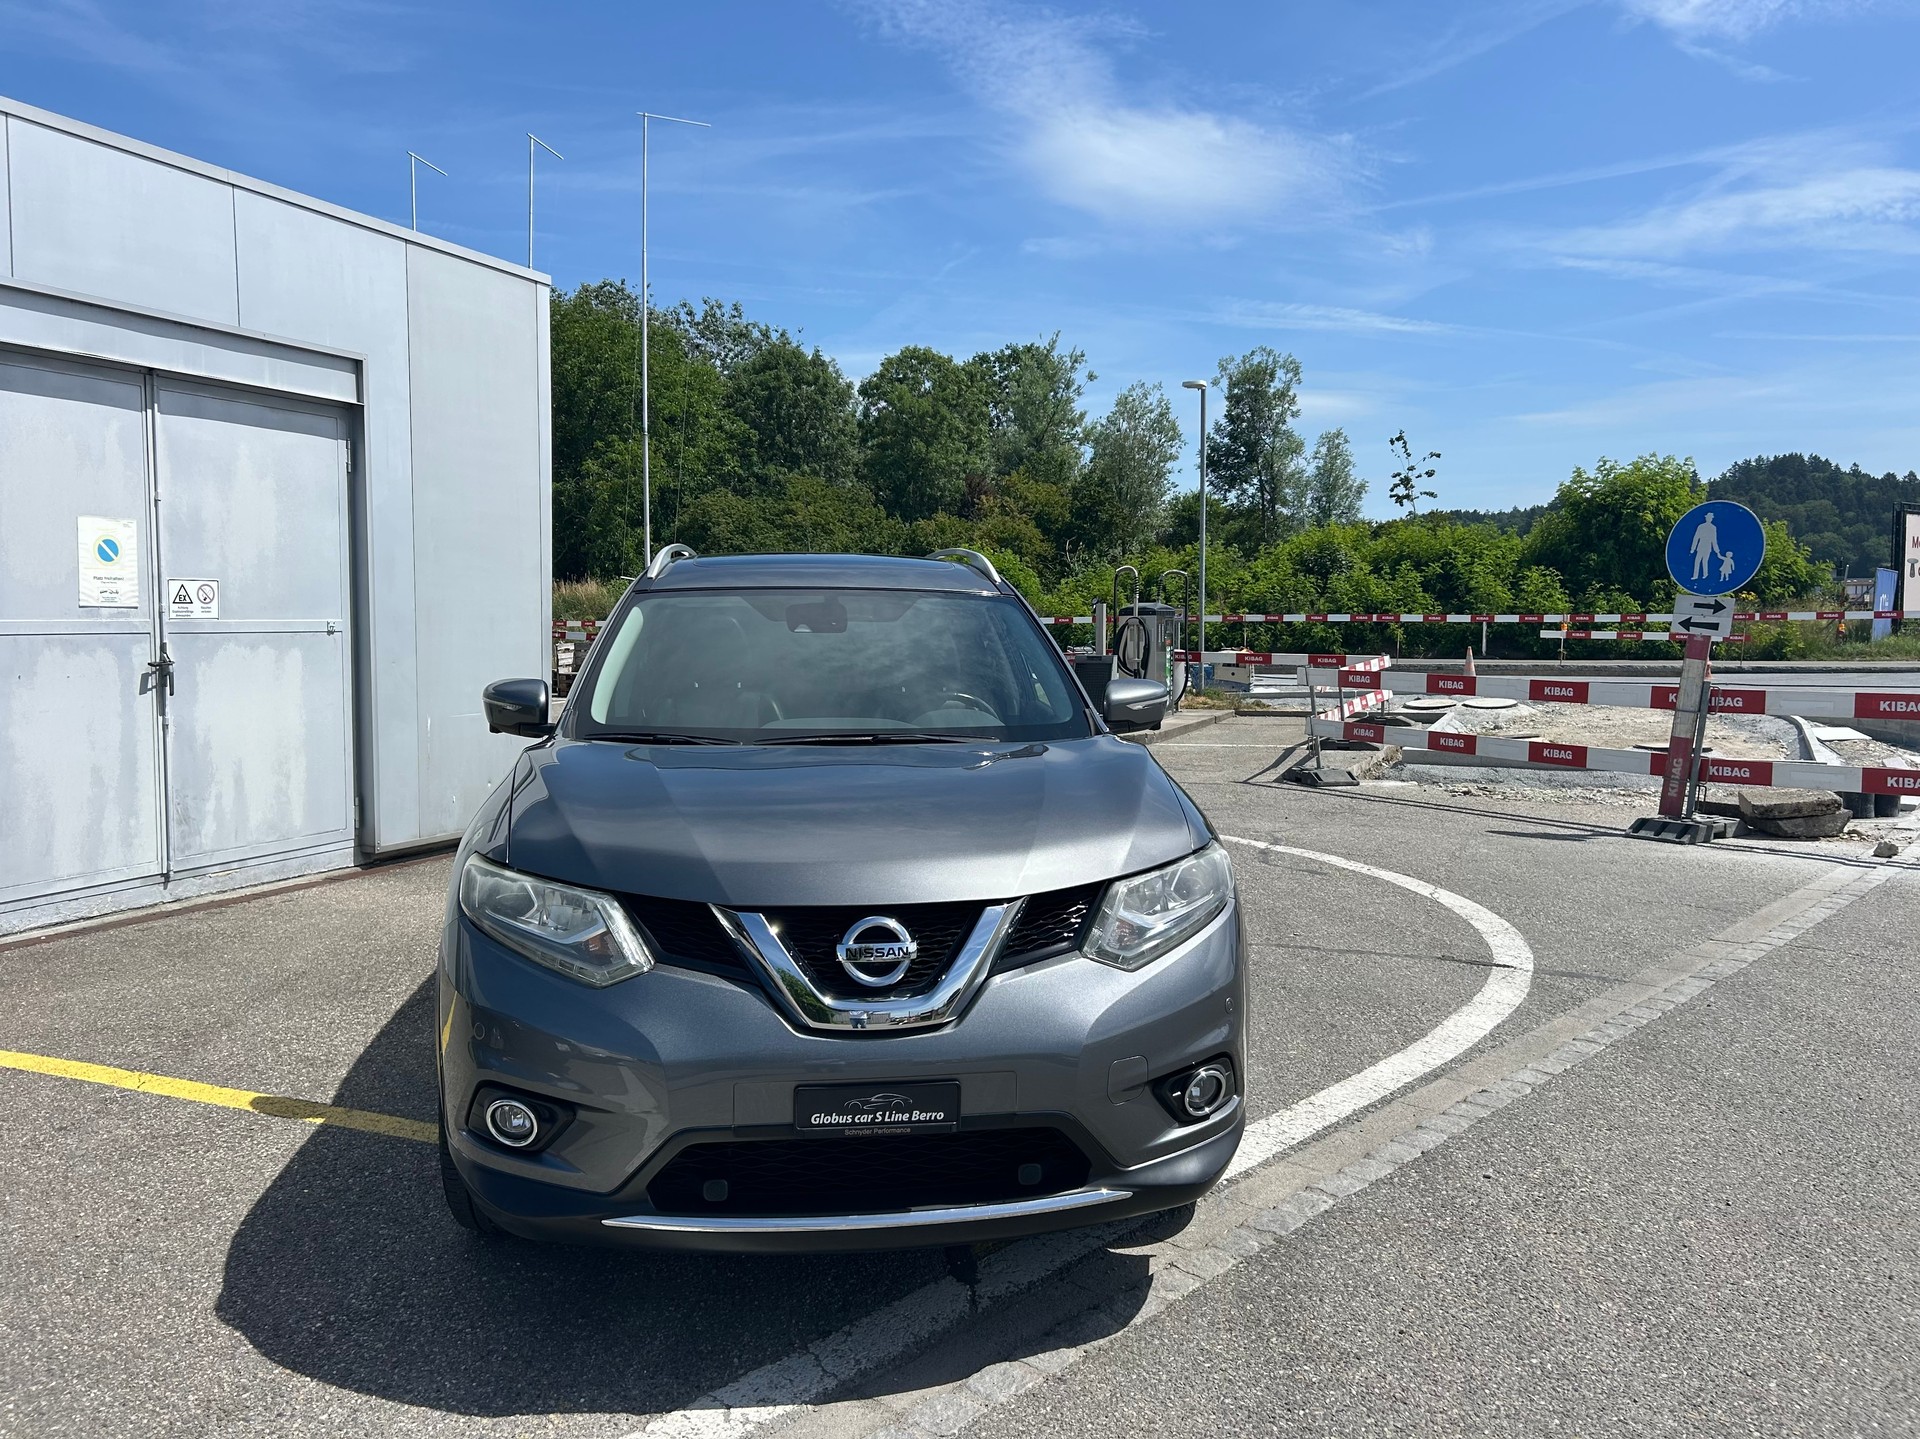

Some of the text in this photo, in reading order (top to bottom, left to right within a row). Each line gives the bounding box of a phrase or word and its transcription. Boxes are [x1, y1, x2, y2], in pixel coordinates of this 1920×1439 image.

[1912, 535, 1920, 549] M
[178, 594, 187, 602] EX
[1348, 674, 1371, 684] KIBAG
[1438, 680, 1464, 690] KIBAG
[1544, 686, 1574, 697] KIBAG
[1708, 696, 1743, 708] IBAG
[1880, 700, 1920, 712] KIBA
[1353, 727, 1375, 738] KIBAG
[1440, 737, 1465, 748] KIBAG
[1543, 748, 1573, 760] KIBAG
[1667, 758, 1683, 797] KIBAG
[1709, 765, 1751, 778] KIBAG
[845, 946, 909, 959] NISSAN
[811, 1110, 944, 1124] Globus car S Line Berro
[844, 1127, 911, 1136] Schnyder Performance
